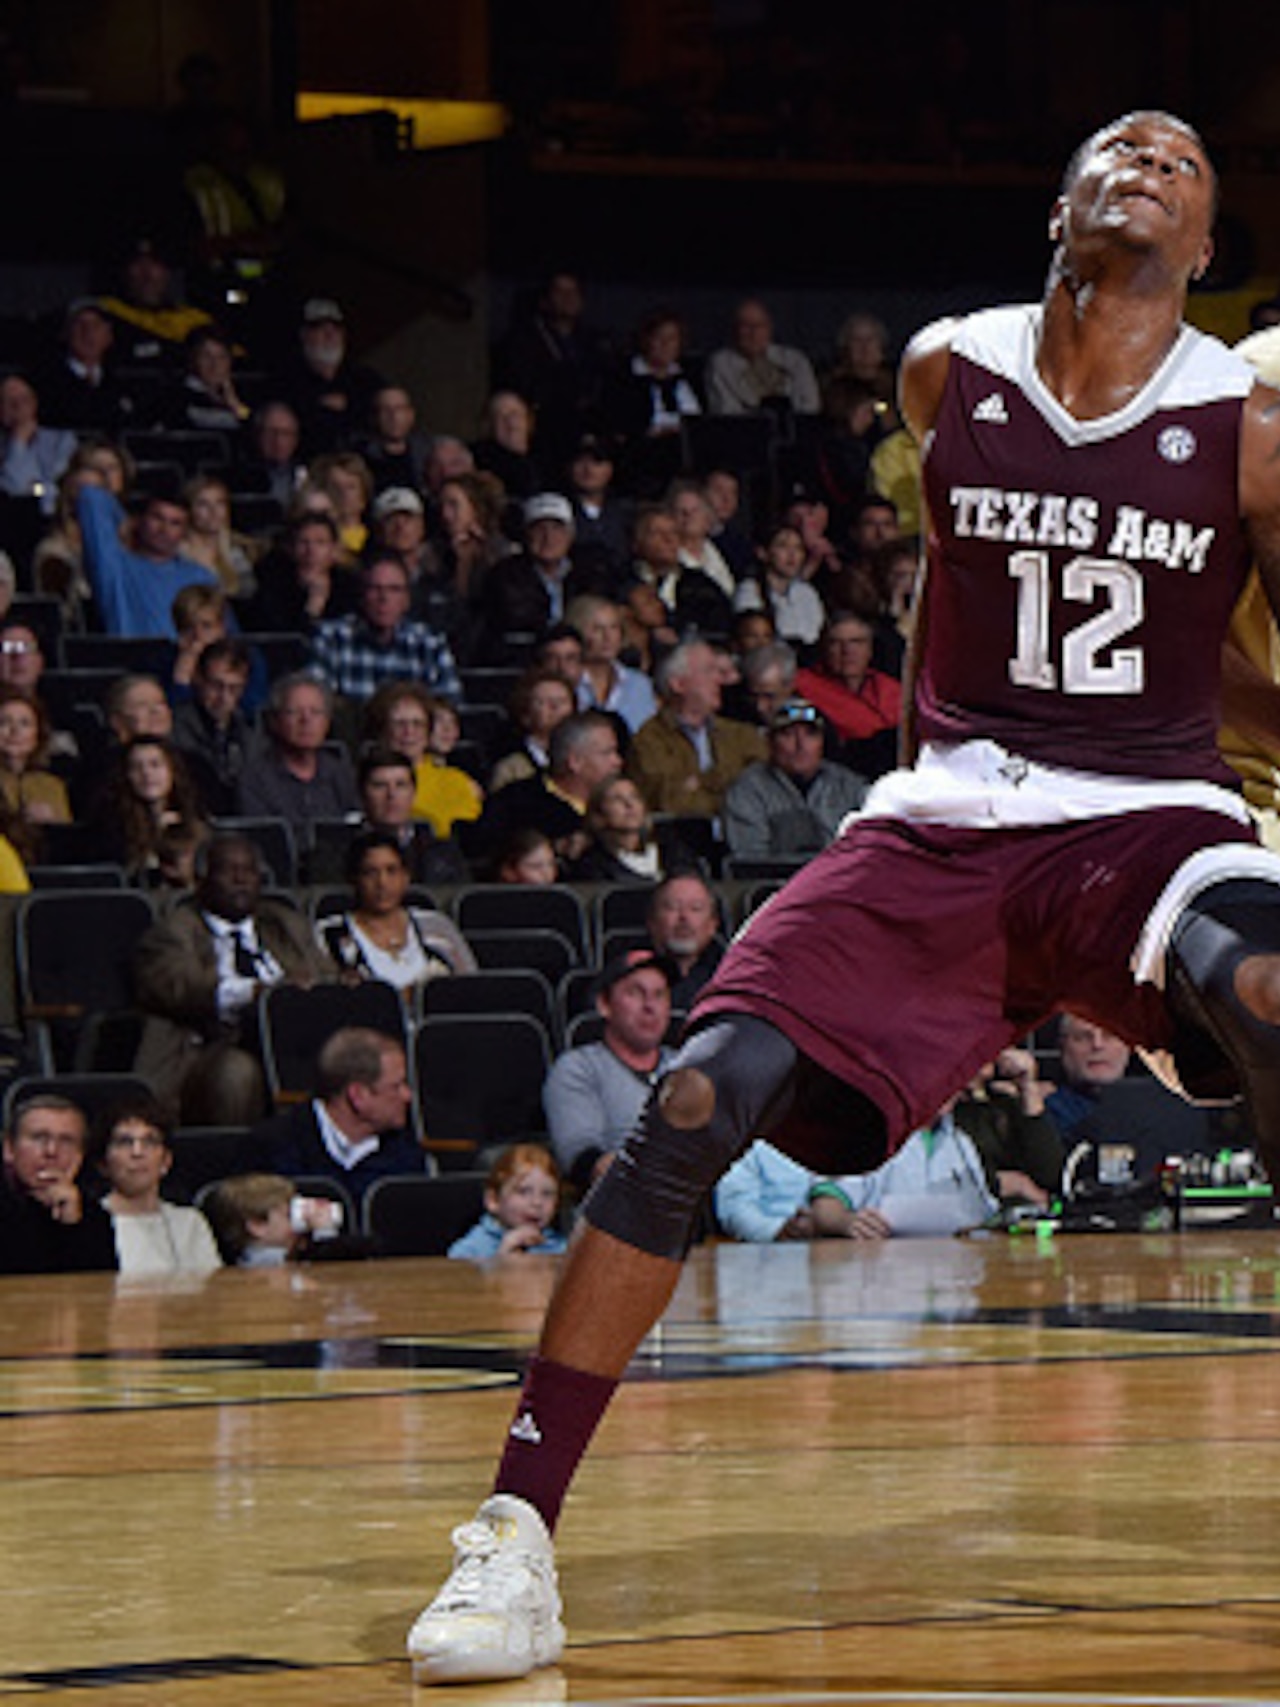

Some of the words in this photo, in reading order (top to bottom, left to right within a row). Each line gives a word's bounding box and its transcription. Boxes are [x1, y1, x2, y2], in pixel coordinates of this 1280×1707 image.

[949, 486, 1099, 549] TEXAS
[1107, 505, 1216, 573] A&M
[1008, 549, 1144, 695] 12
